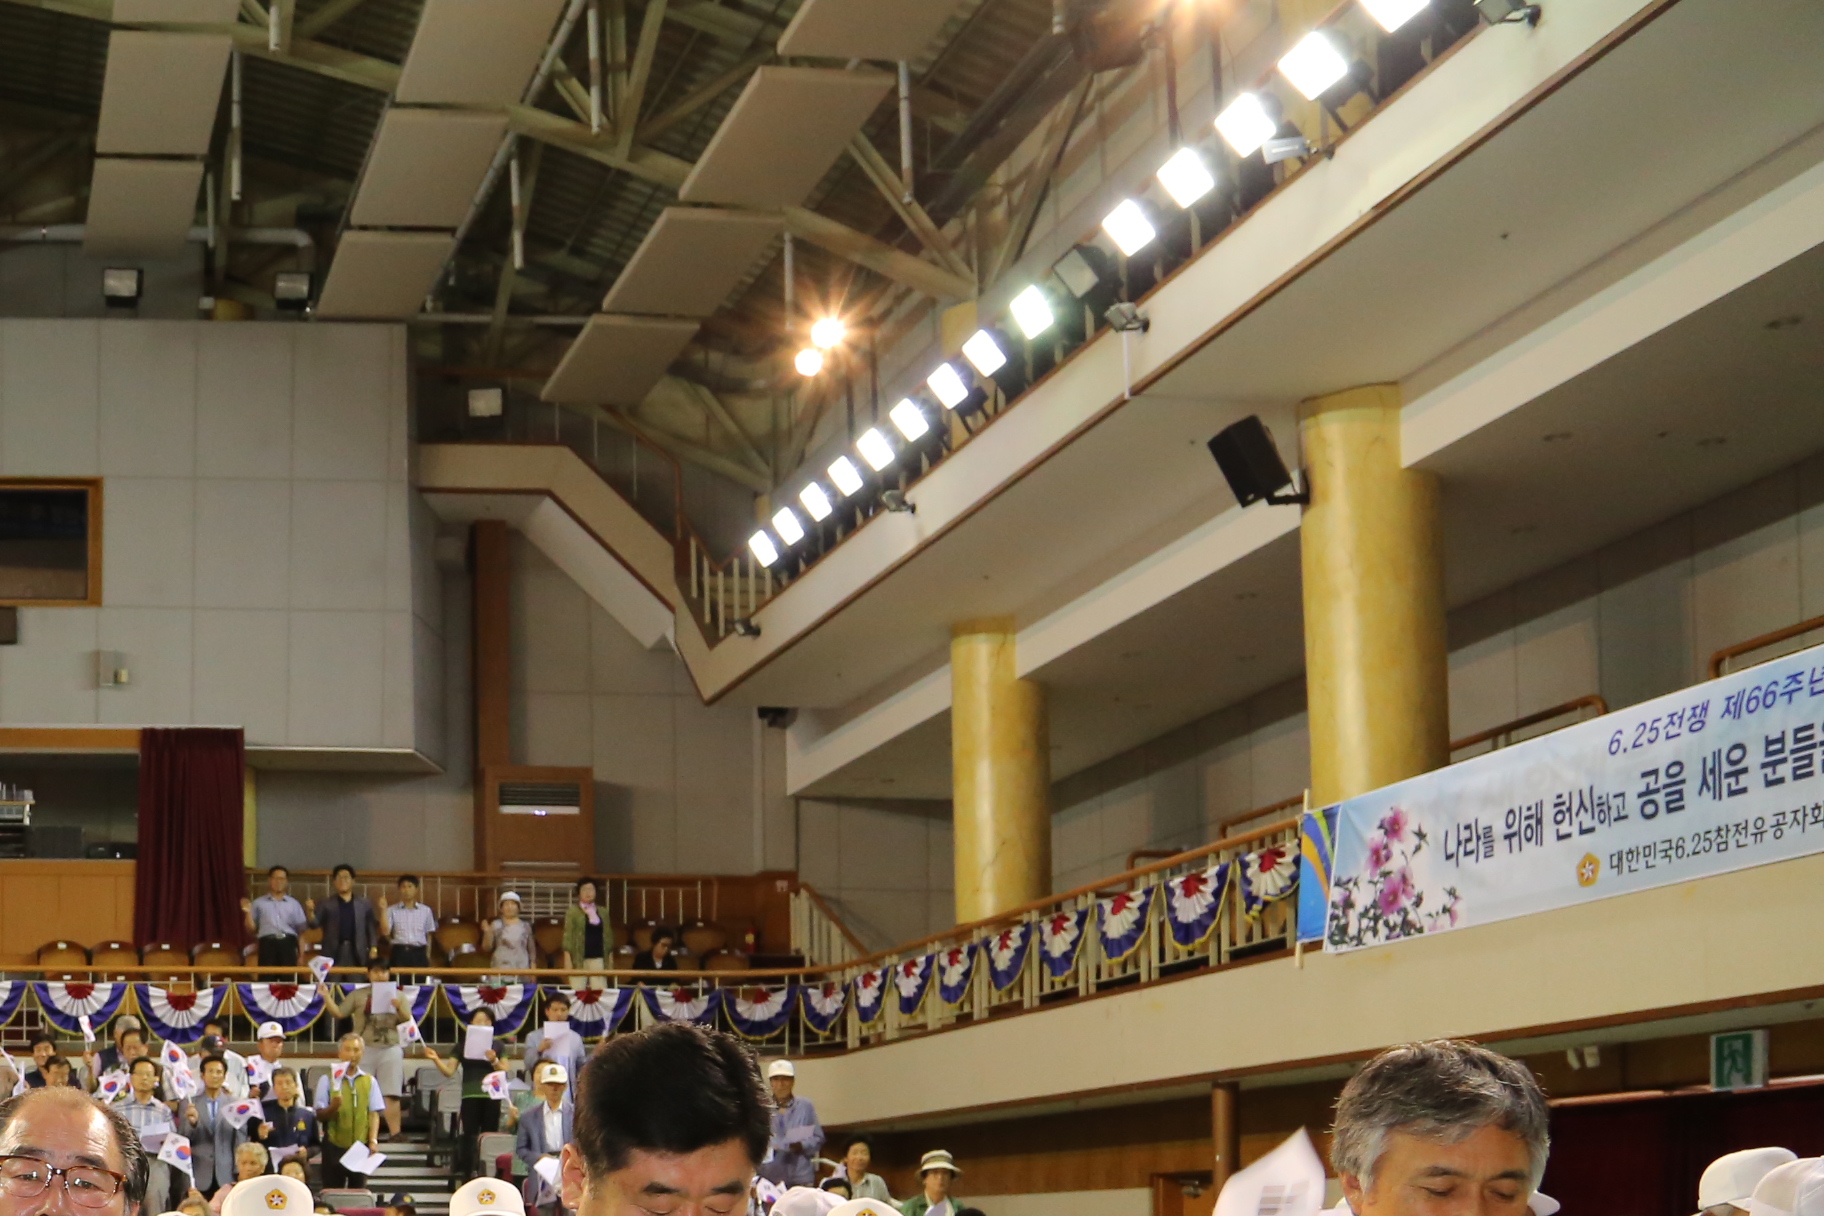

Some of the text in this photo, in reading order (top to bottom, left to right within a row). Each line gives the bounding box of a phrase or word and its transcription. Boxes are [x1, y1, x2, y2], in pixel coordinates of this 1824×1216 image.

[1608, 699, 1710, 756] 6.25전쟁
[1443, 722, 1824, 868] 나라를 위해 헌신하고 공을 세운 분들
